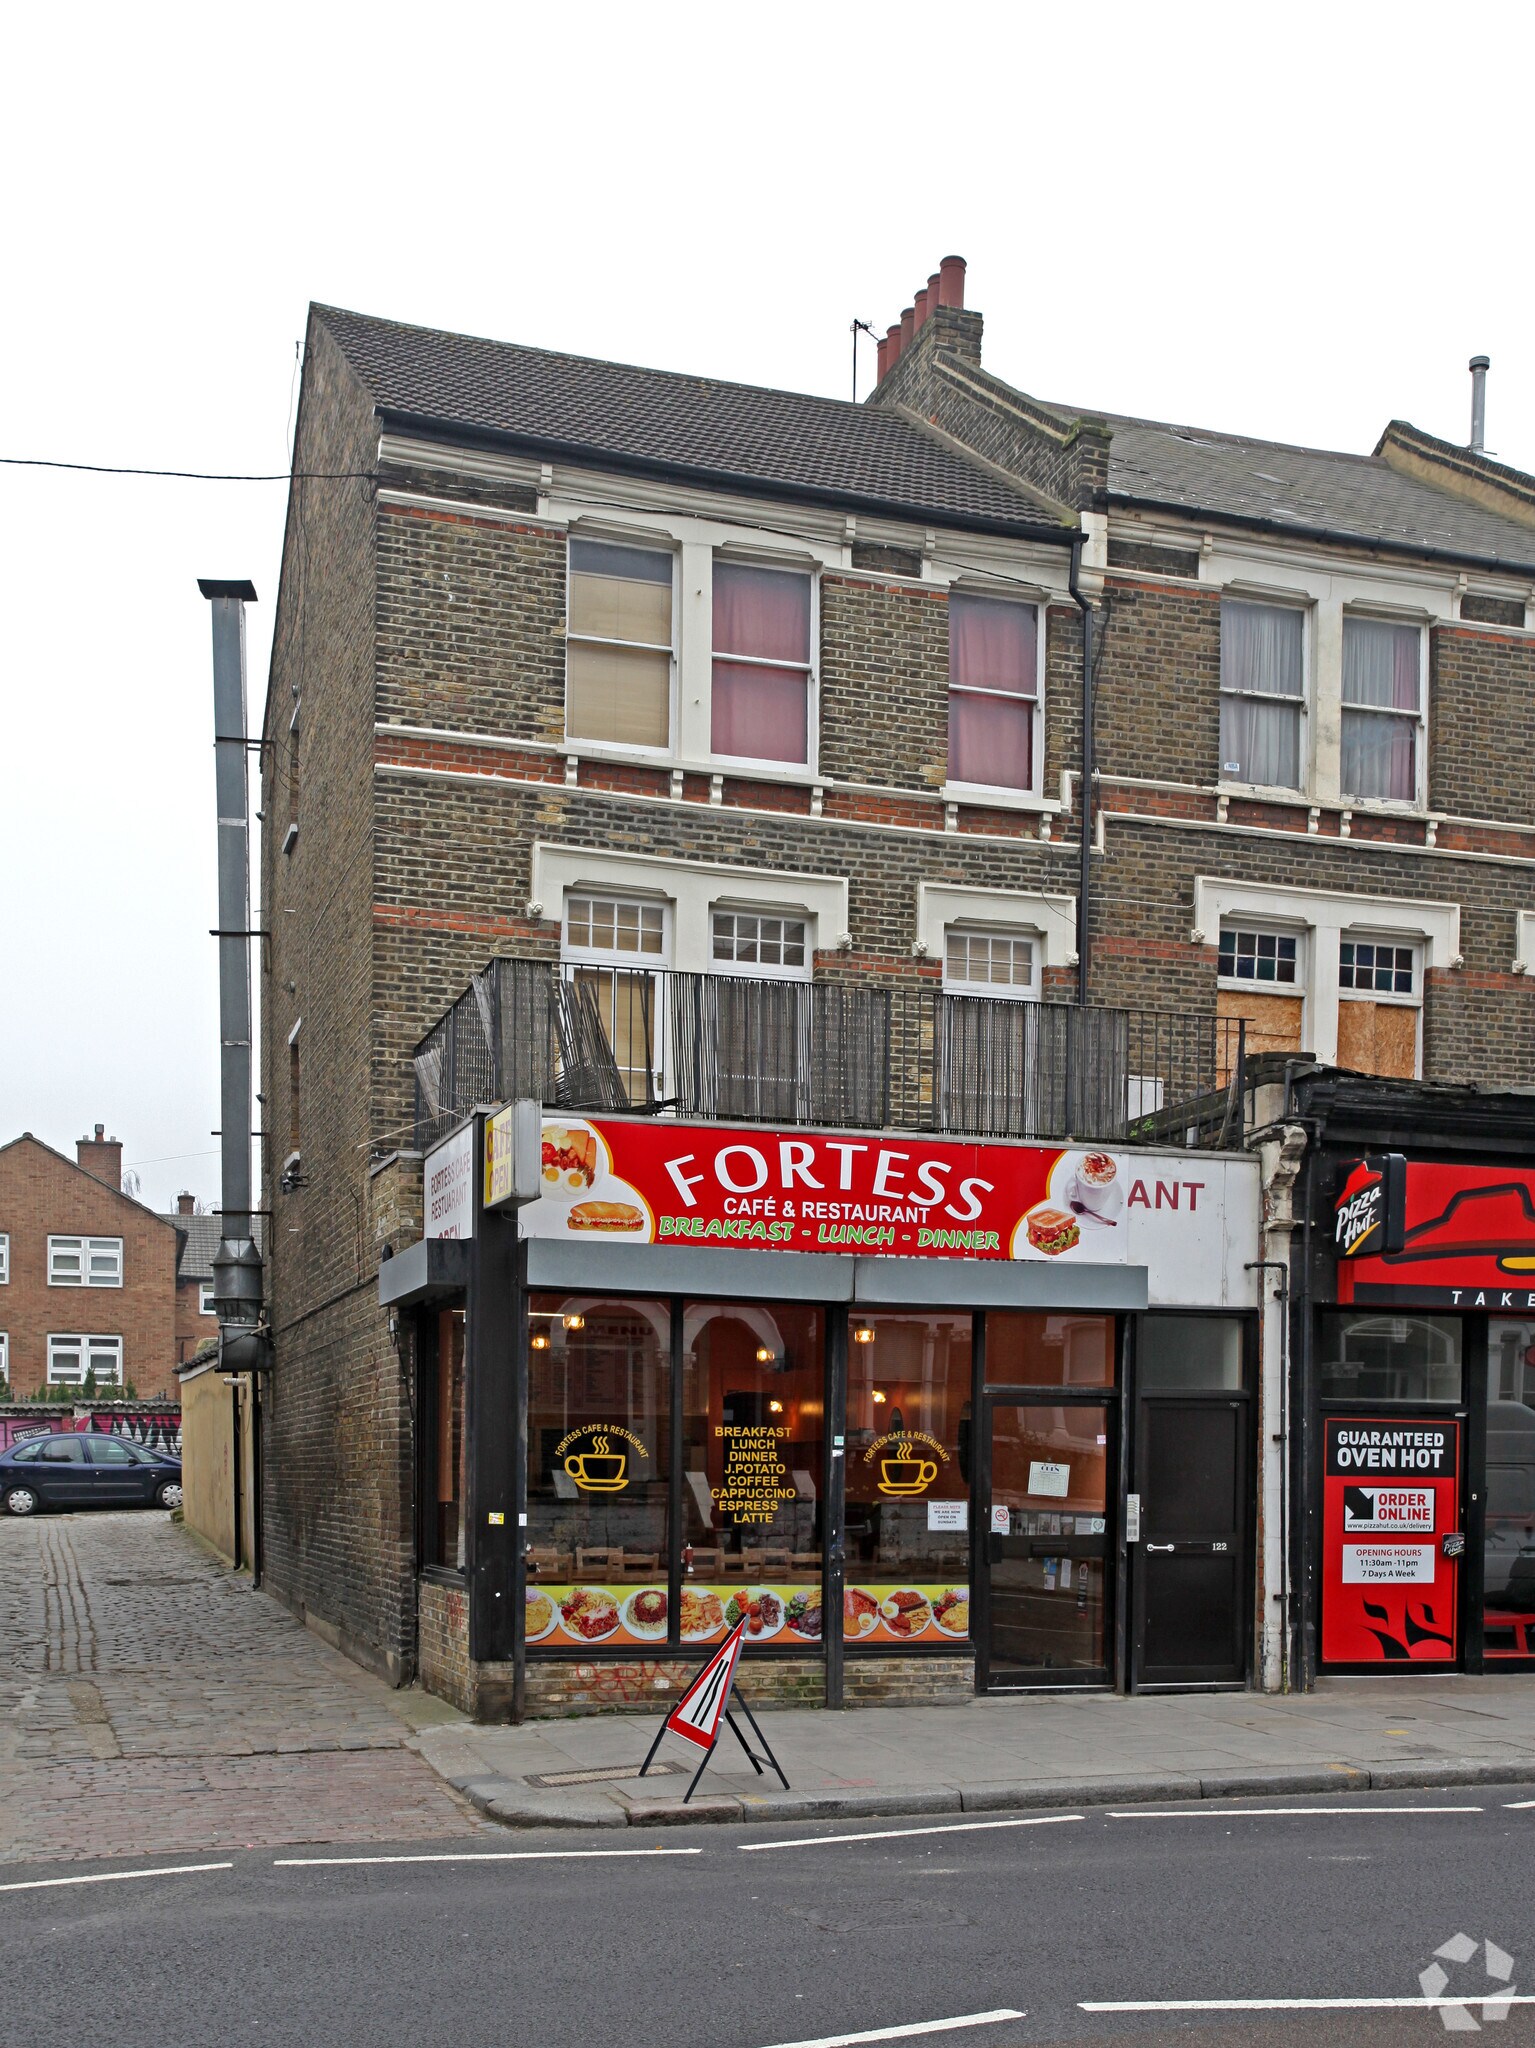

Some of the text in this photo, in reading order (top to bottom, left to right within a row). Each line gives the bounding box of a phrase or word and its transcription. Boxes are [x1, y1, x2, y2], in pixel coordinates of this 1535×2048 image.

[487, 1119, 511, 1163] CAFE
[488, 1162, 509, 1199] OPEN
[664, 1141, 994, 1221] FORTESS
[723, 1196, 931, 1224] CAFÉ & RESTAURANT
[1335, 1187, 1382, 1242] Pizza
[659, 1216, 795, 1241] BREAKFAST
[818, 1223, 895, 1246] LUNCH
[917, 1228, 1000, 1250] DINNER
[1343, 1208, 1377, 1249] Hut
[715, 1426, 793, 1438] BREAKFAST
[554, 1424, 649, 1458] FORTESS CAFE & RESTAURANT
[731, 1439, 776, 1450] LUNCH
[1337, 1431, 1444, 1447] GUARANTEED
[863, 1430, 951, 1463] FORTESS CAFE & RESTAURANT
[729, 1451, 778, 1462] DINNER
[1337, 1448, 1444, 1468] OVEN HOT
[724, 1463, 786, 1474] J.POTATO
[728, 1476, 779, 1487] COFFEE
[711, 1488, 796, 1499] CAPPUCCINO
[1378, 1493, 1426, 1506] ORDER
[719, 1500, 779, 1511] ESPRESS
[733, 1513, 774, 1524] LATTE
[1378, 1508, 1431, 1521] ONLINE
[1346, 1522, 1432, 1530] www.pizzahut.co.uk/delivery
[1212, 1542, 1228, 1551] 122
[1368, 1571, 1387, 1579] Days
